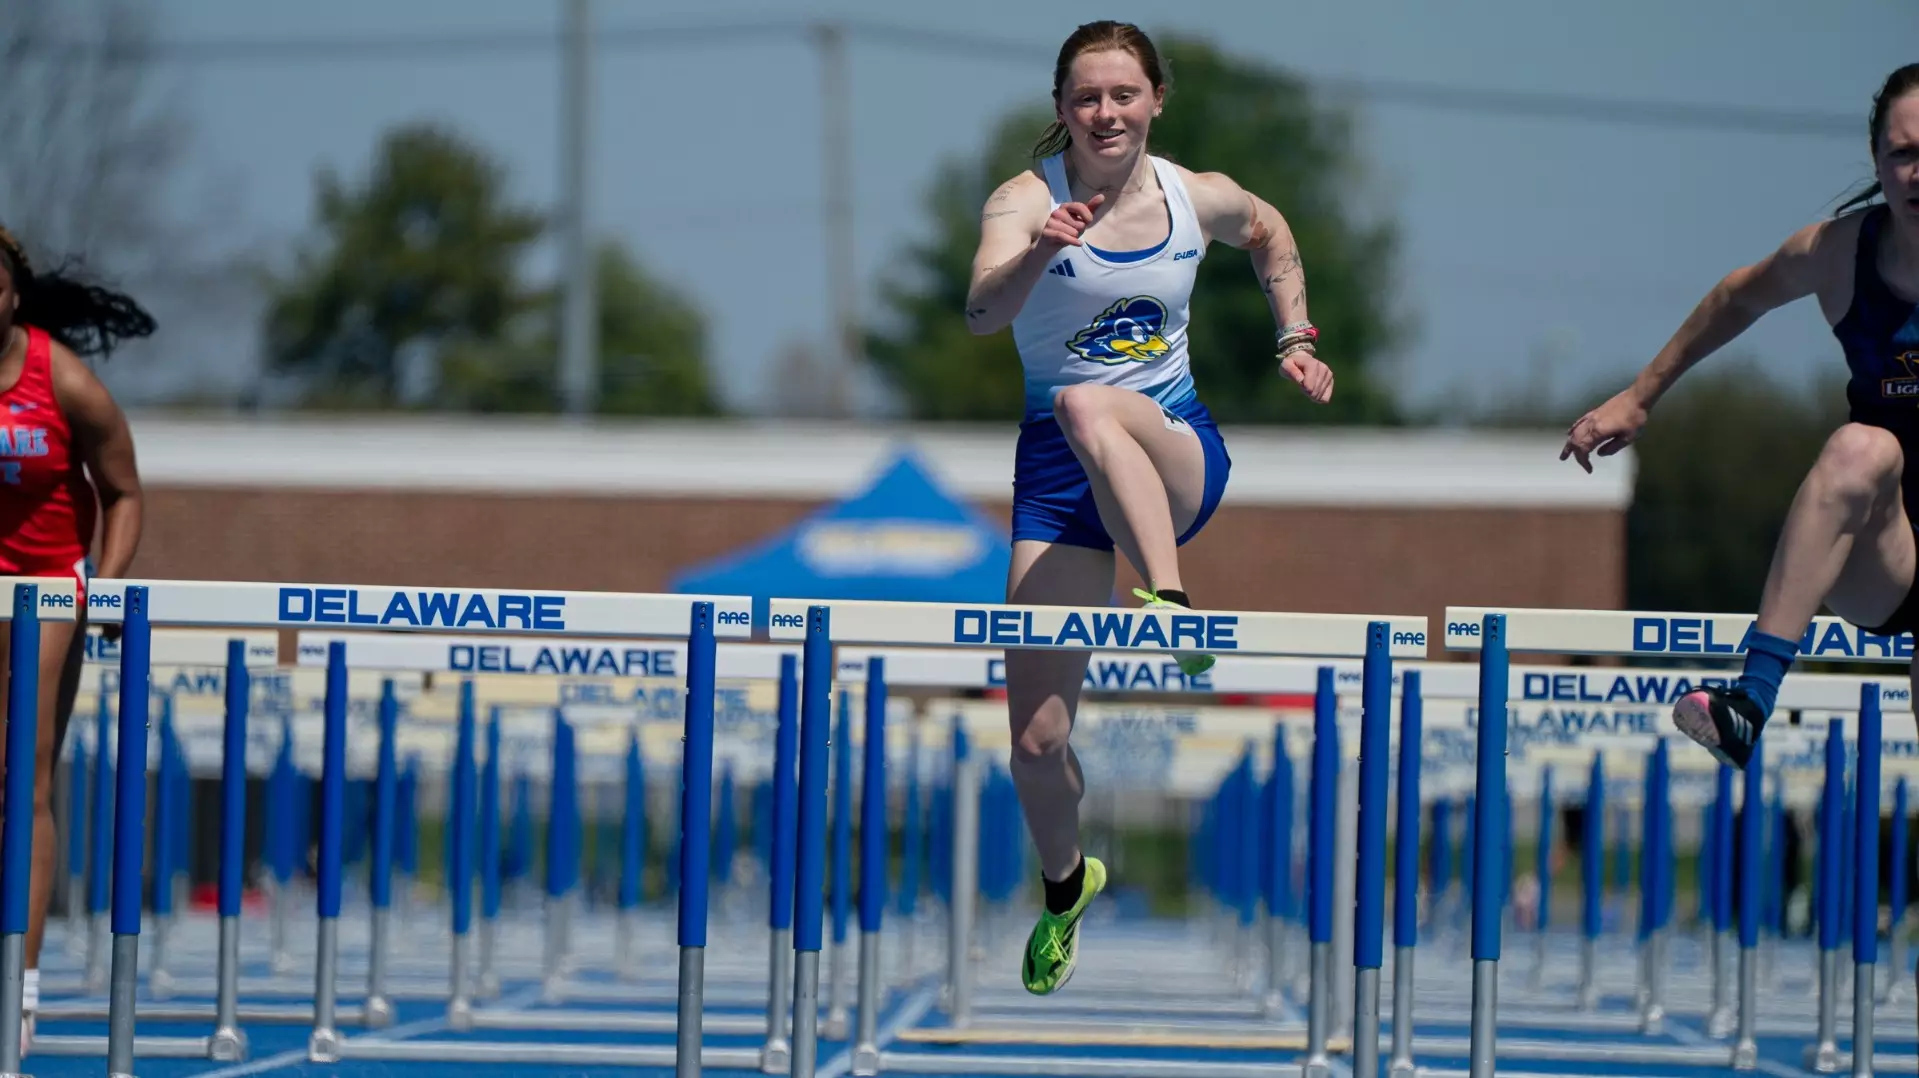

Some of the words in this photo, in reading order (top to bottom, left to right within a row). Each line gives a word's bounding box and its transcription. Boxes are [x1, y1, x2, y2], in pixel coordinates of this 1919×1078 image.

[278, 587, 566, 630] DELAWARE
[954, 609, 1239, 649] DELAWARE
[1633, 617, 1915, 658] DELARE
[449, 645, 677, 677] DELAWARE
